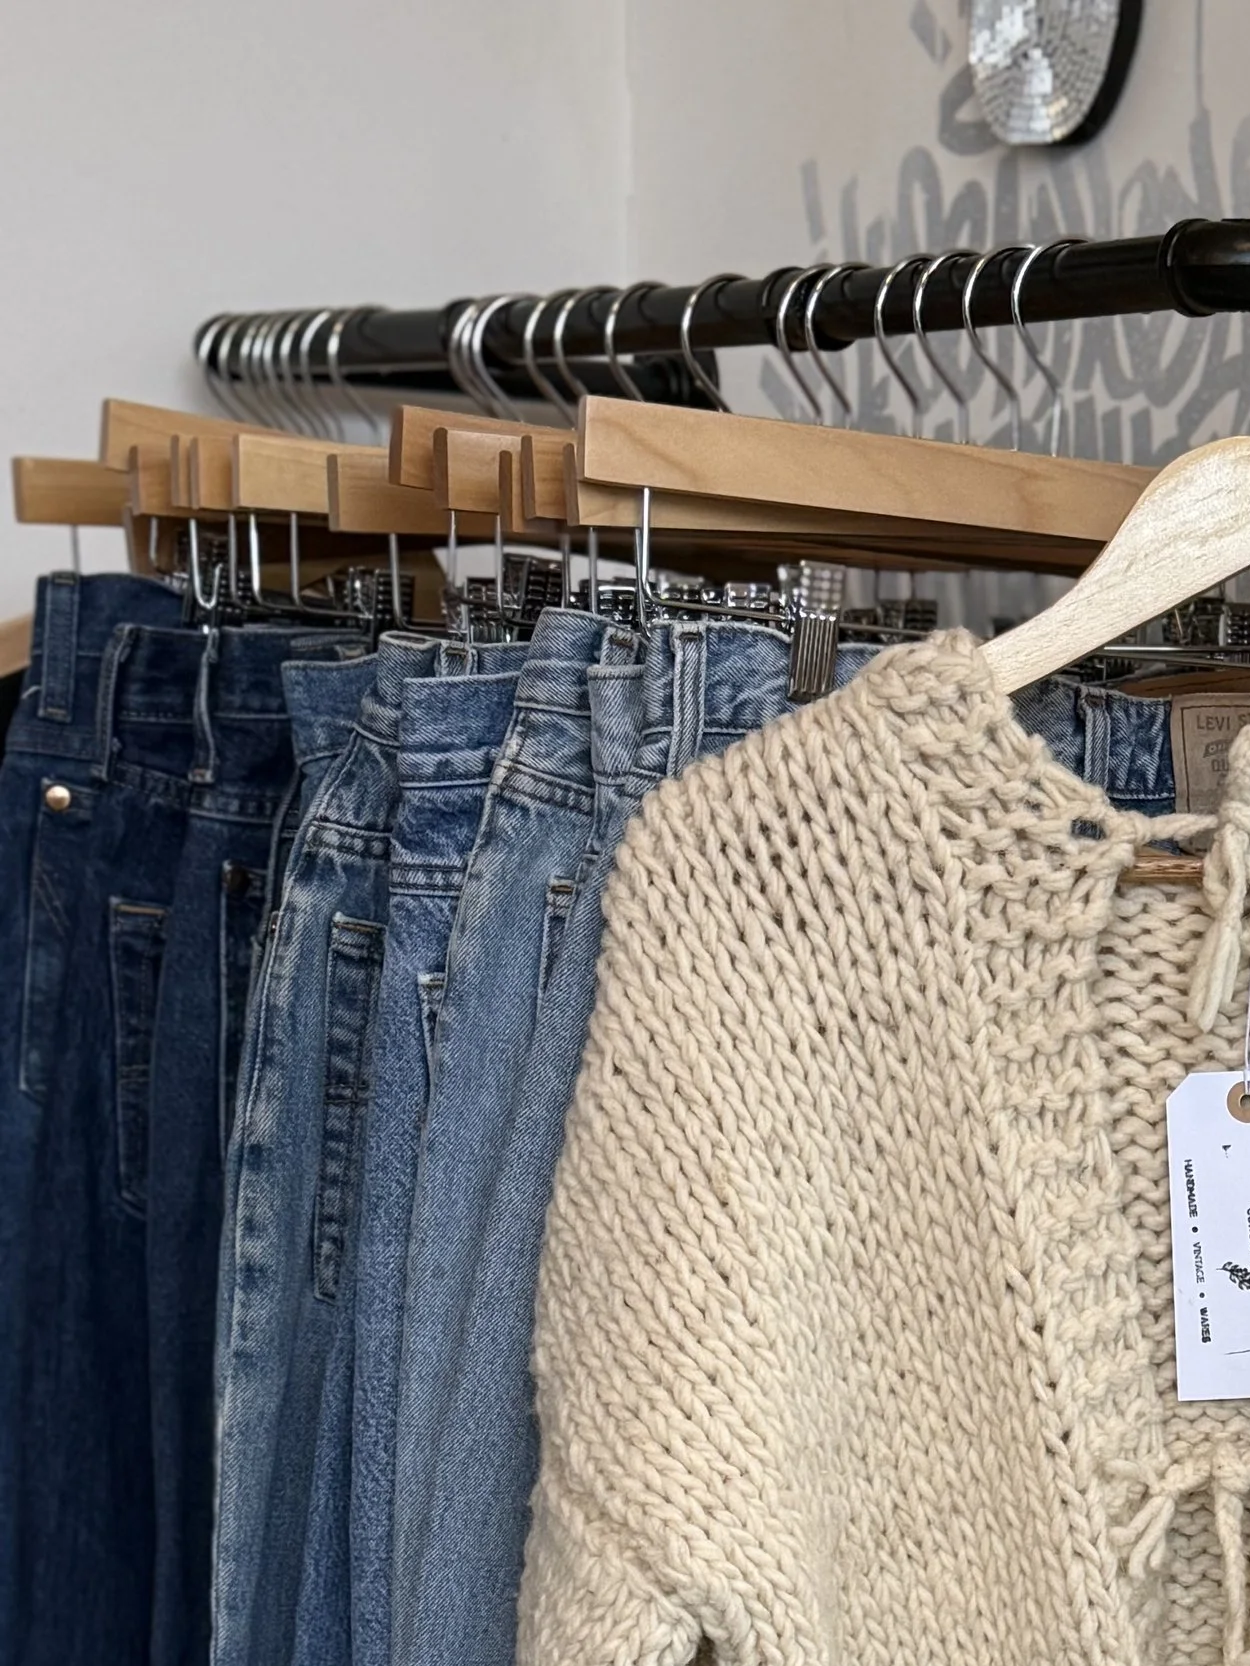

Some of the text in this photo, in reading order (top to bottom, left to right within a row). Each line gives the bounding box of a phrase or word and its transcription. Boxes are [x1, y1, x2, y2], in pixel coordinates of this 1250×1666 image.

[1196, 714, 1231, 732] LEVI
[1183, 1158, 1212, 1344] HANDMADE VINTAGE WARES
